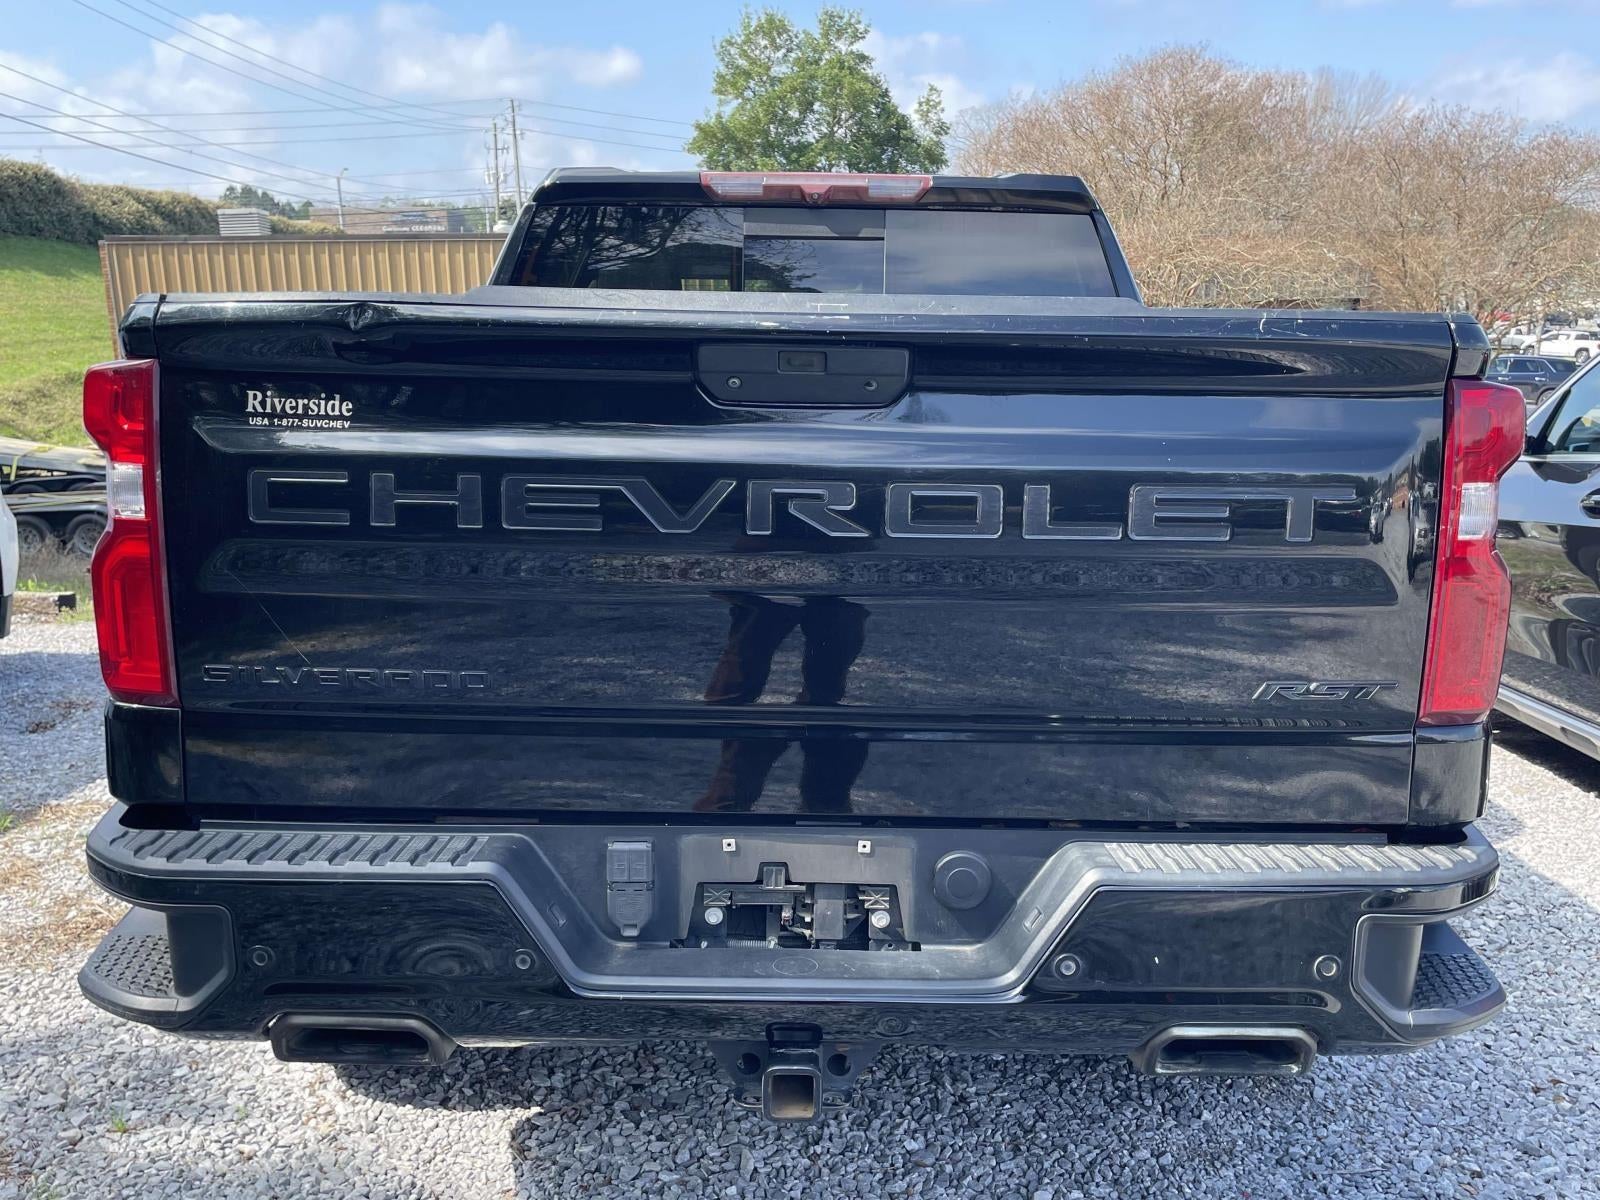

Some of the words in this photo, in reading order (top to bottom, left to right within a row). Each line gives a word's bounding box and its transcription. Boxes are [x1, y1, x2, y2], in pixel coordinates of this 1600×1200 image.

[245, 390, 353, 416] Riverside
[249, 417, 270, 426] USA
[273, 418, 351, 429] 1-877-SUVCHEV
[248, 469, 1357, 543] CHEVROLET
[202, 664, 492, 689] SILVERADO
[1251, 680, 1399, 701] RST
